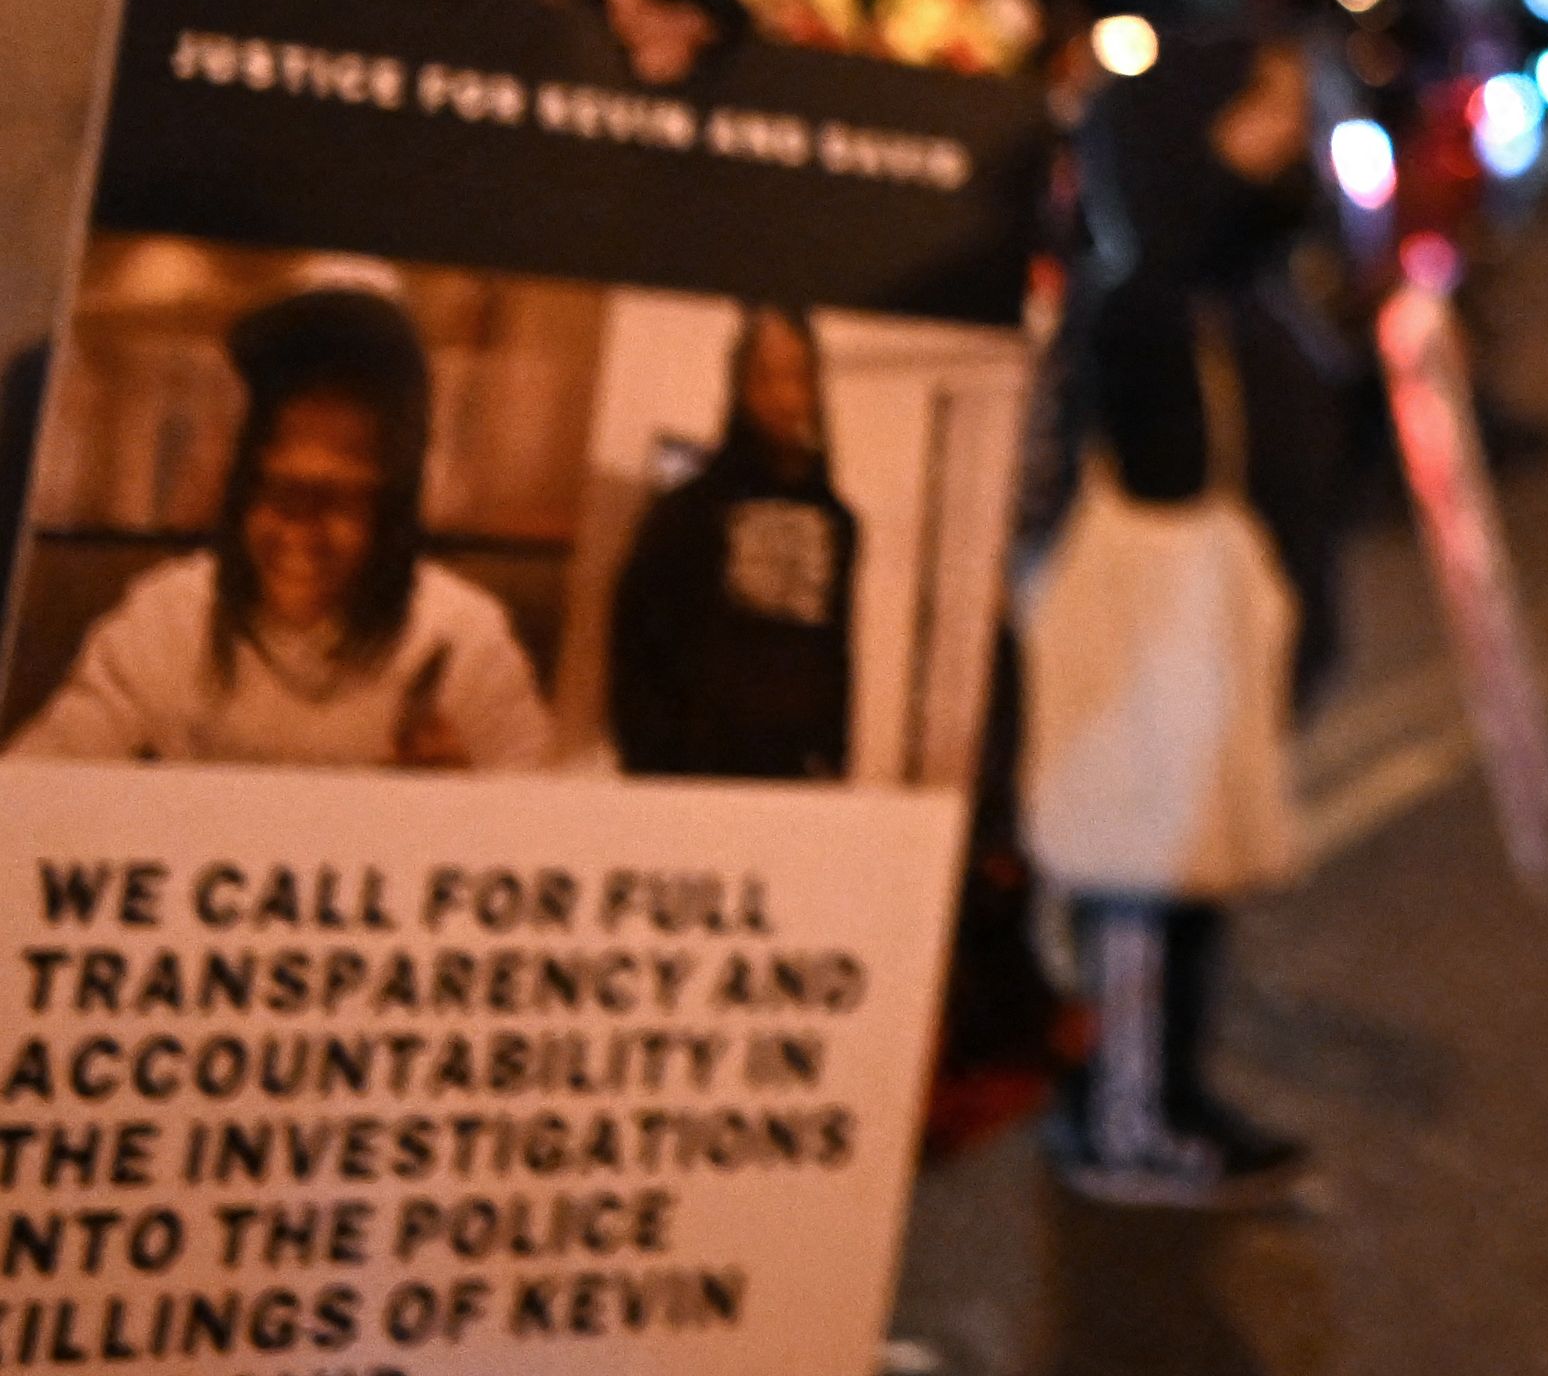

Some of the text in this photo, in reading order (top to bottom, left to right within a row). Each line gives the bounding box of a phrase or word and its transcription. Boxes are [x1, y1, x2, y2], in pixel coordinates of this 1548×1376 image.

[170, 29, 404, 112] JUSTICE
[415, 61, 528, 127] FOR
[38, 859, 776, 937] WE CALL FOR FULL
[26, 947, 867, 1017] TRANSPARENCY AND
[2, 1028, 824, 1101] ACCOUNTABILITY IN
[0, 1104, 856, 1191] THE INVESTIGATIONS
[2, 1187, 676, 1278] NTO THE POLICE
[0, 1265, 748, 1367] ILLINGS OF KEVIN
